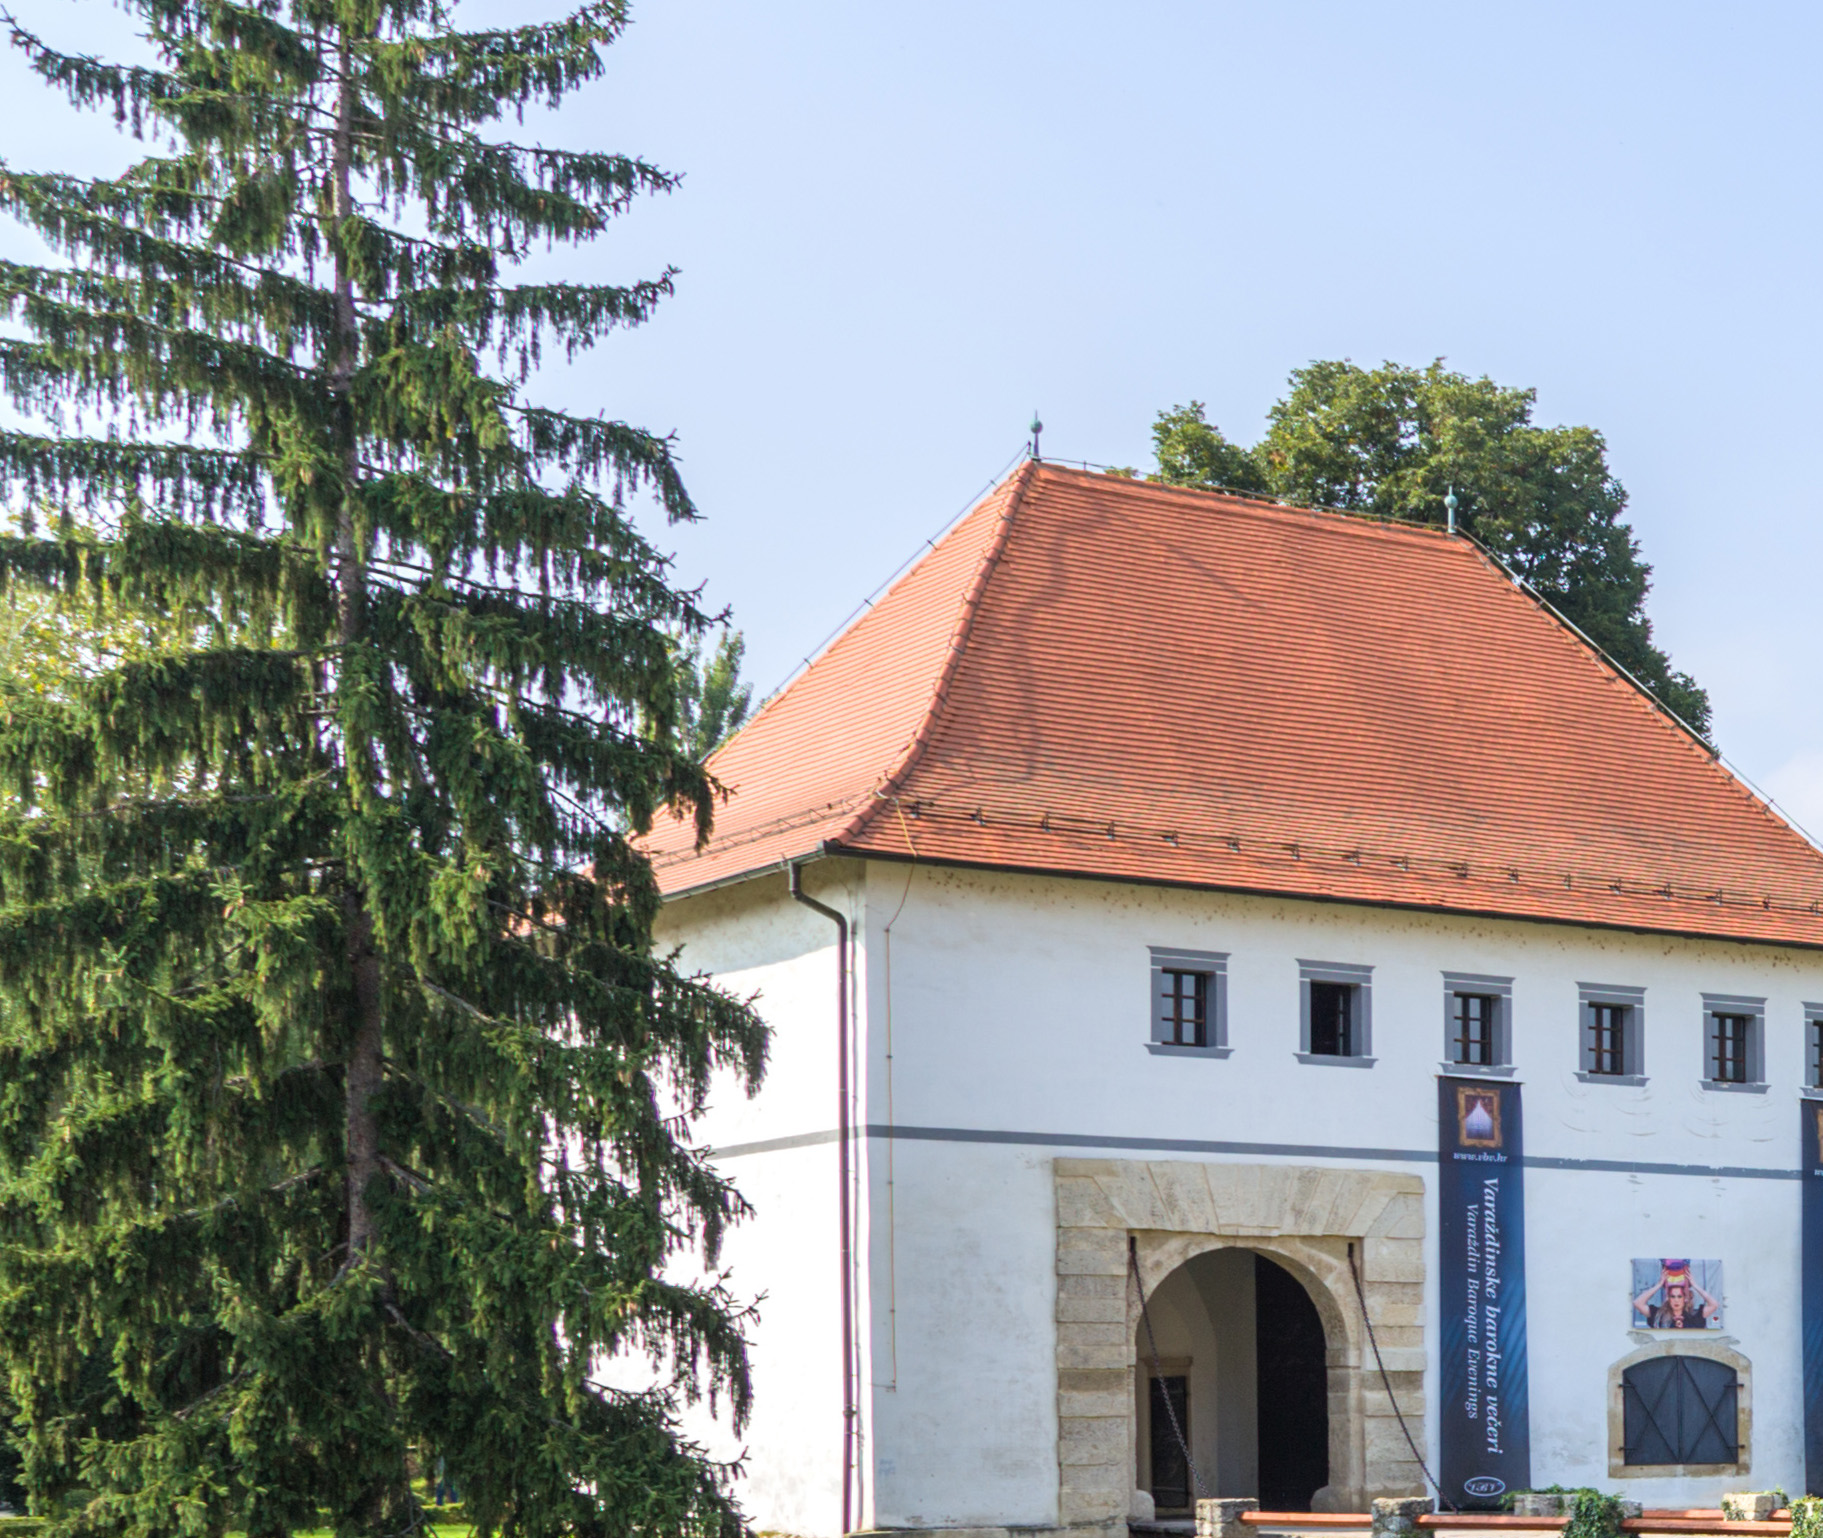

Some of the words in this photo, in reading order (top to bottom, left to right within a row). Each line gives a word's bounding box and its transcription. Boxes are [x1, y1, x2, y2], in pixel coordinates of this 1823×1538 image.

[1466, 1204, 1481, 1273] Varaždin
[1484, 1178, 1501, 1299] Varaždinske
[1464, 1278, 1480, 1343] Baroque
[1485, 1305, 1502, 1388] barokne
[1465, 1348, 1481, 1419] Evenings
[1486, 1395, 1504, 1453] večeri
